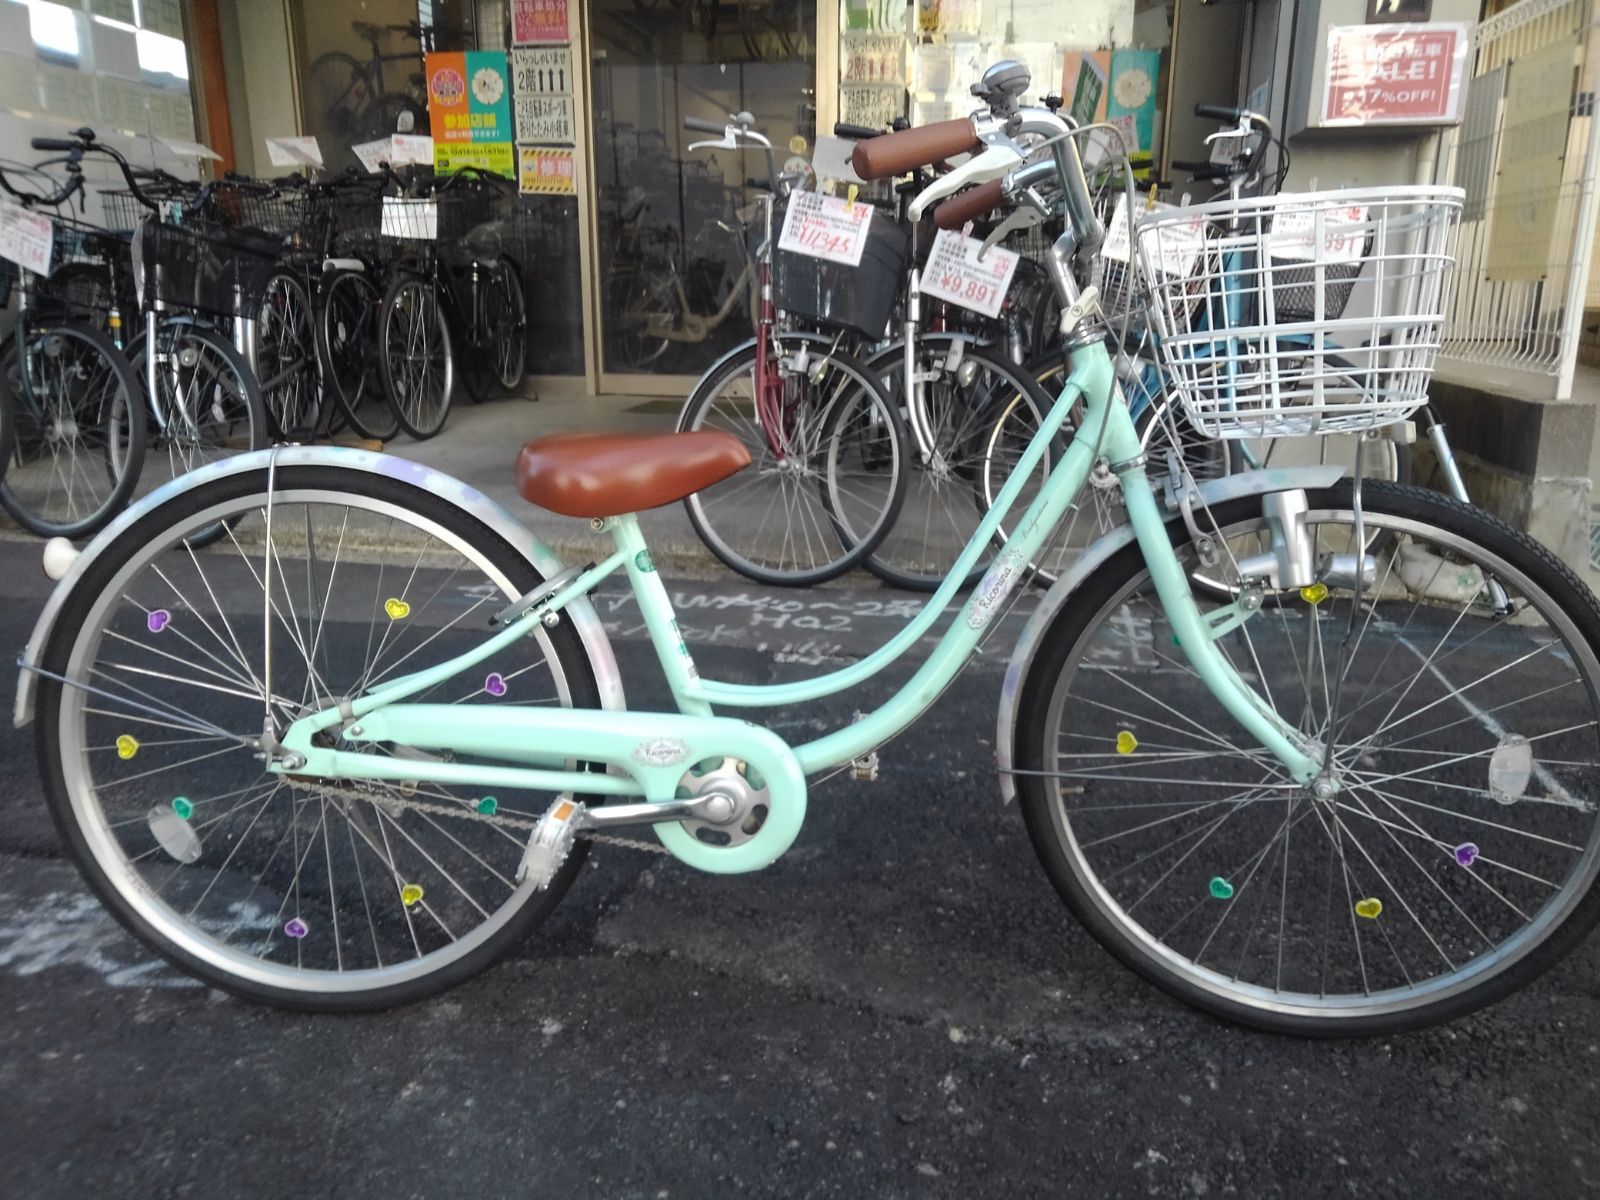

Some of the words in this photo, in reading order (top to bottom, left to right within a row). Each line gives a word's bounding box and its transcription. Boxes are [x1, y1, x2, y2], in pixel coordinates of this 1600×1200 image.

[514, 51, 566, 65] いらっしゃいませ
[518, 68, 537, 92] 2階
[978, 566, 1012, 609] Ricorina
